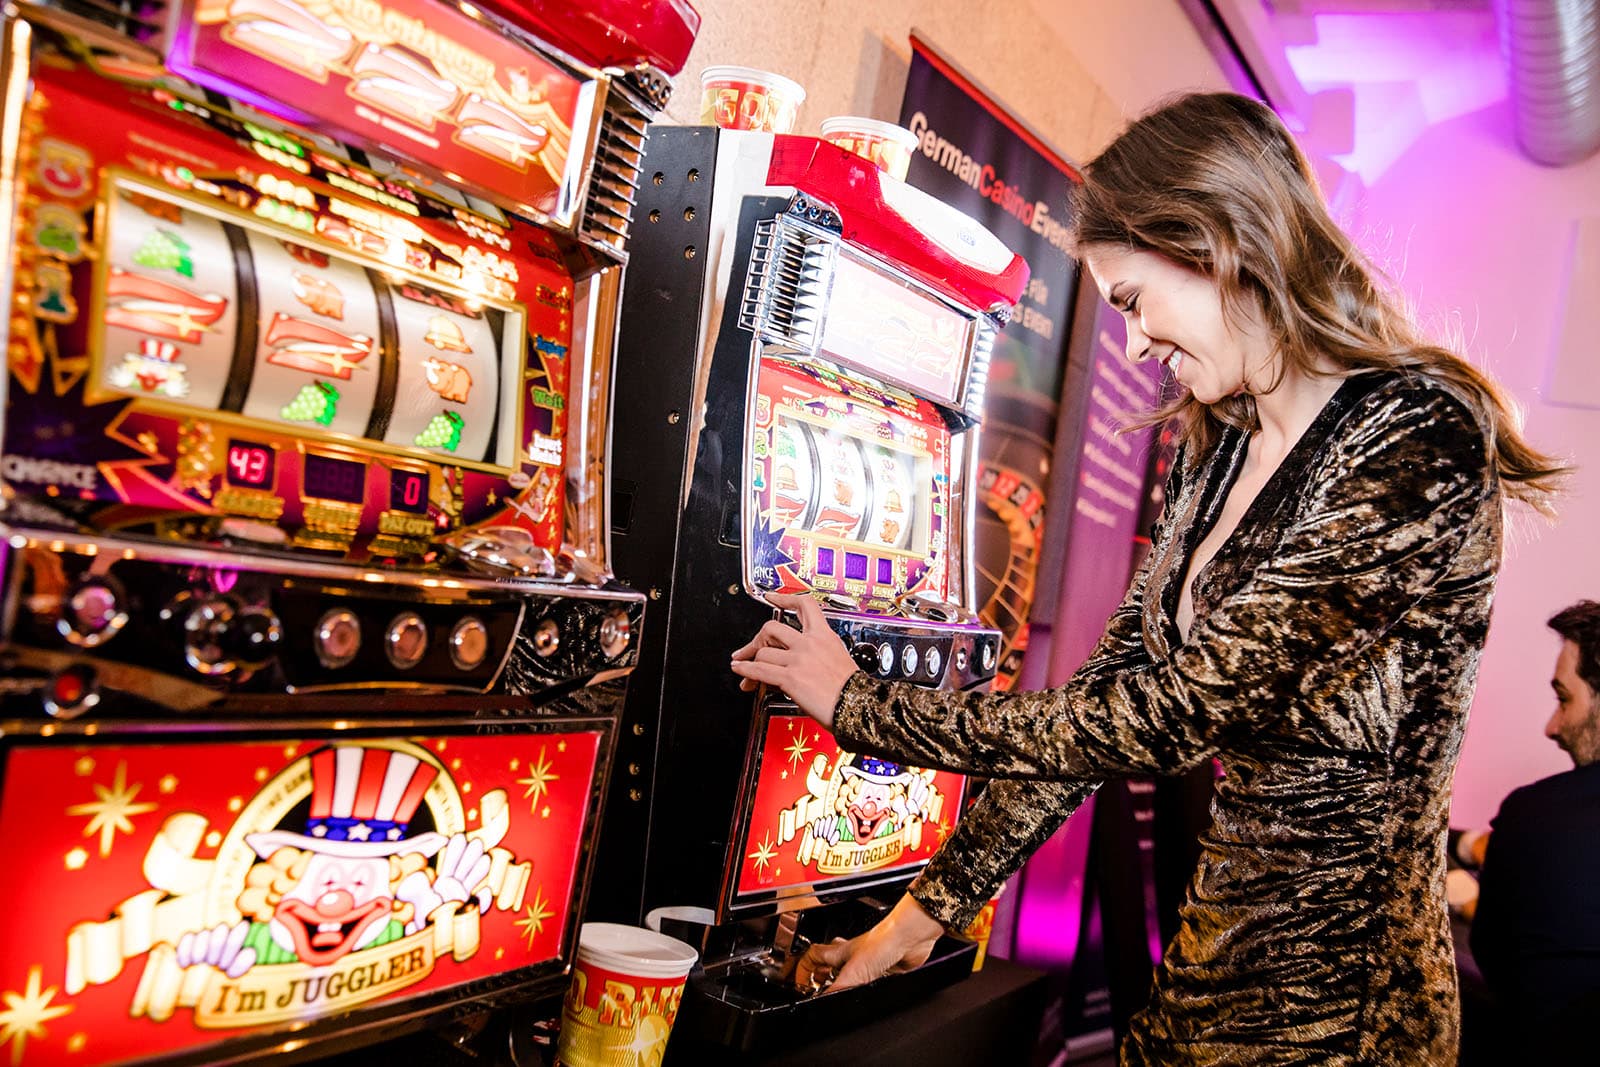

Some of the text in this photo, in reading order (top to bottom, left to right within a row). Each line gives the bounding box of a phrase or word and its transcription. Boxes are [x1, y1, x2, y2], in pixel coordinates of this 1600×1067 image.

[533, 387, 564, 410] Wait
[230, 446, 268, 484] 43
[404, 476, 421, 506] 0
[754, 565, 774, 580] ANCE
[823, 840, 900, 867] I'm JUGGLER
[211, 946, 435, 1015] I'm JUGGLER
